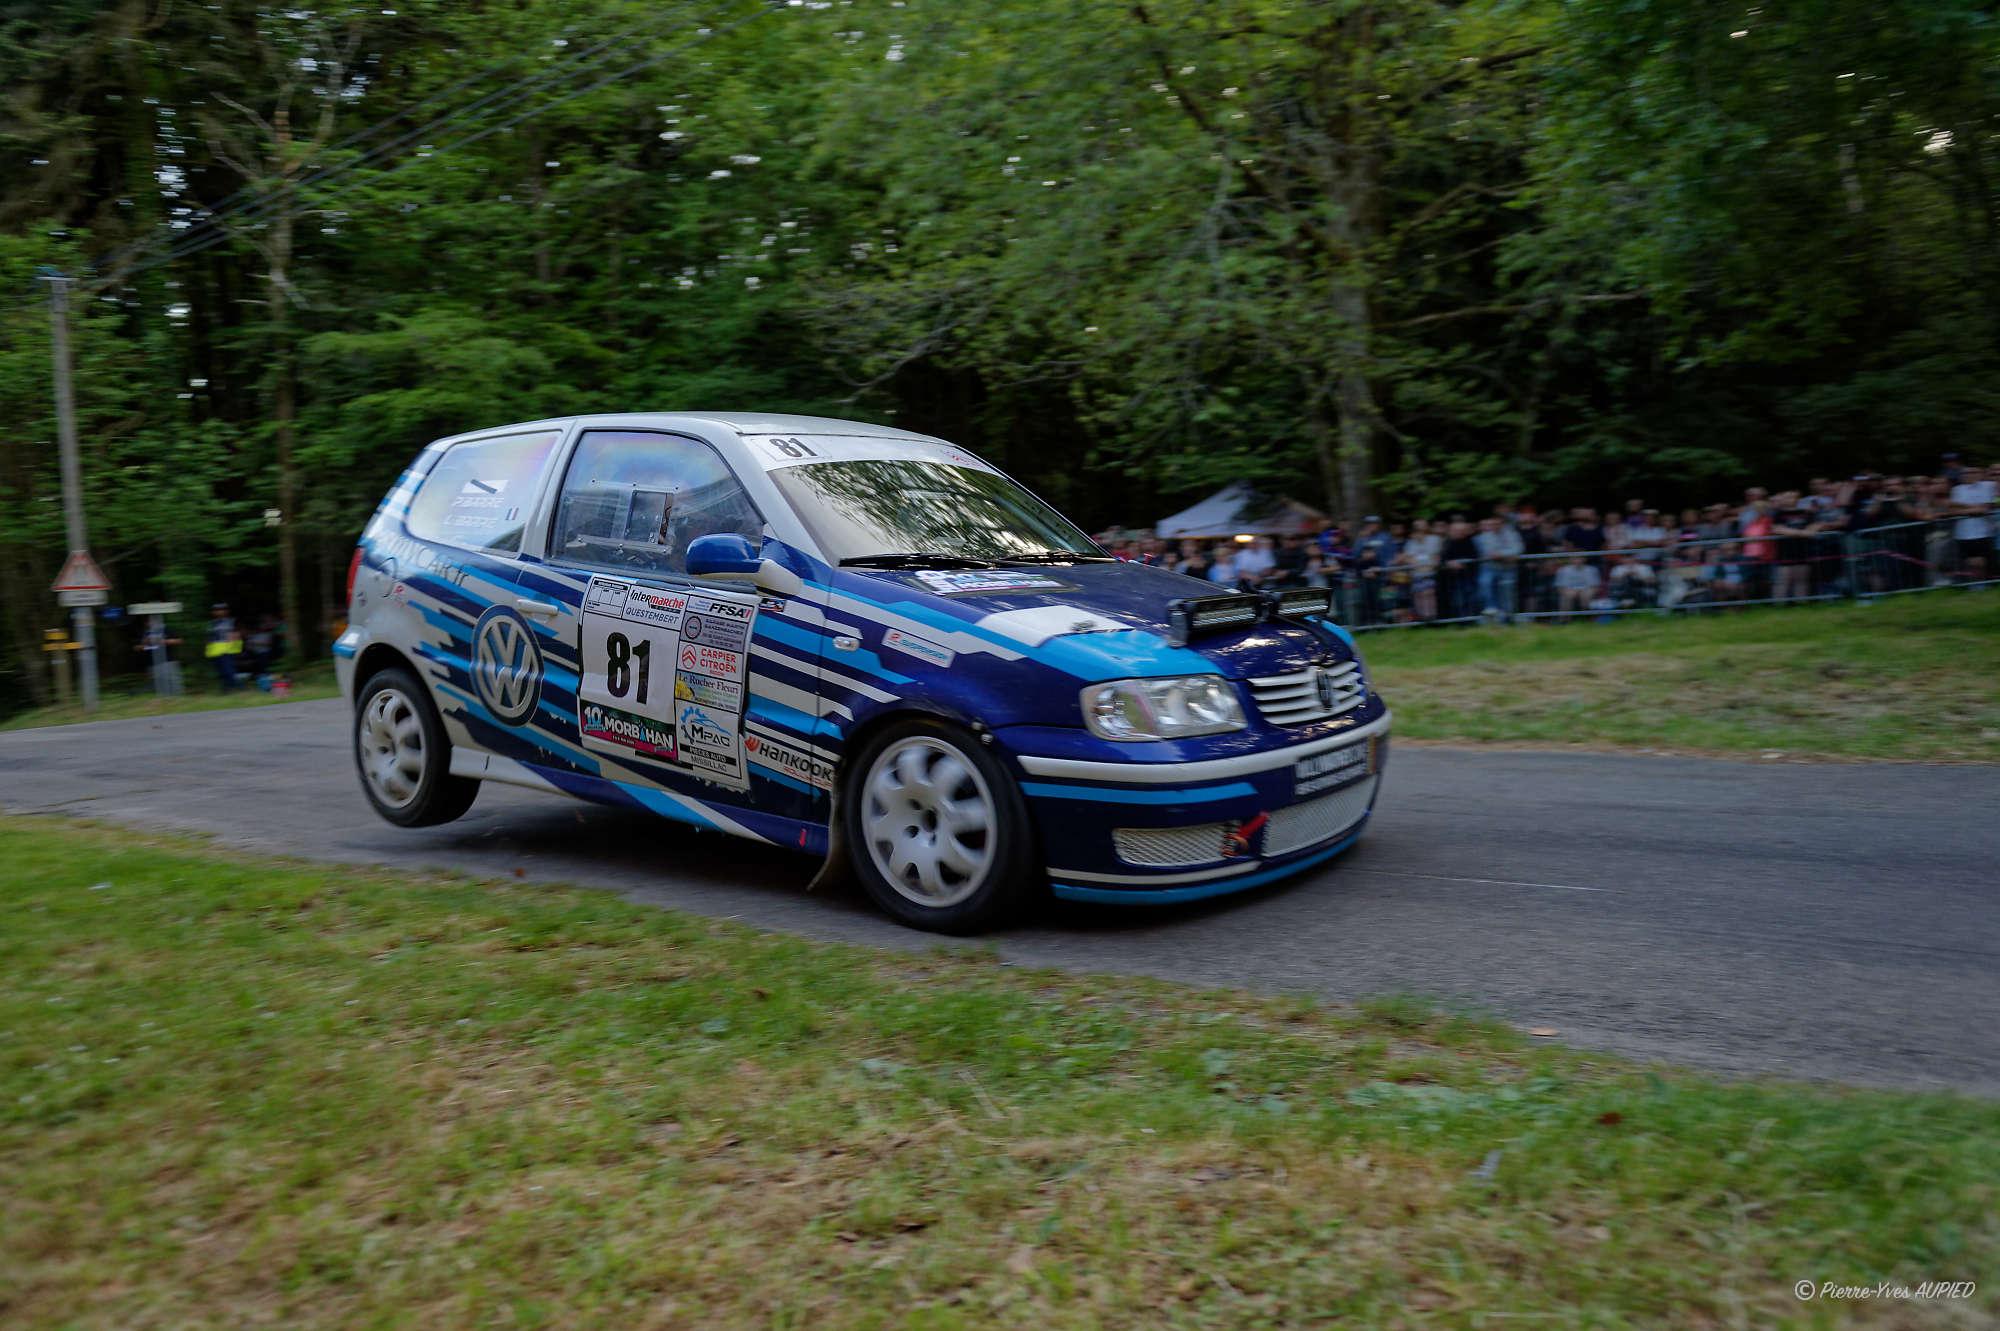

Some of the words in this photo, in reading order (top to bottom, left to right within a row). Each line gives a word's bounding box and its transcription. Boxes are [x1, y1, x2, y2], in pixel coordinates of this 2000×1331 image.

[768, 437, 818, 458] 81
[625, 607, 680, 624] QUESTEMBERT
[709, 603, 746, 618] FFSA
[701, 648, 737, 663] CARPIER
[606, 632, 651, 705] 81
[700, 659, 737, 674] CITROËN
[679, 672, 688, 682] Le
[689, 675, 716, 689] Rocher
[716, 681, 739, 695] Fleuri
